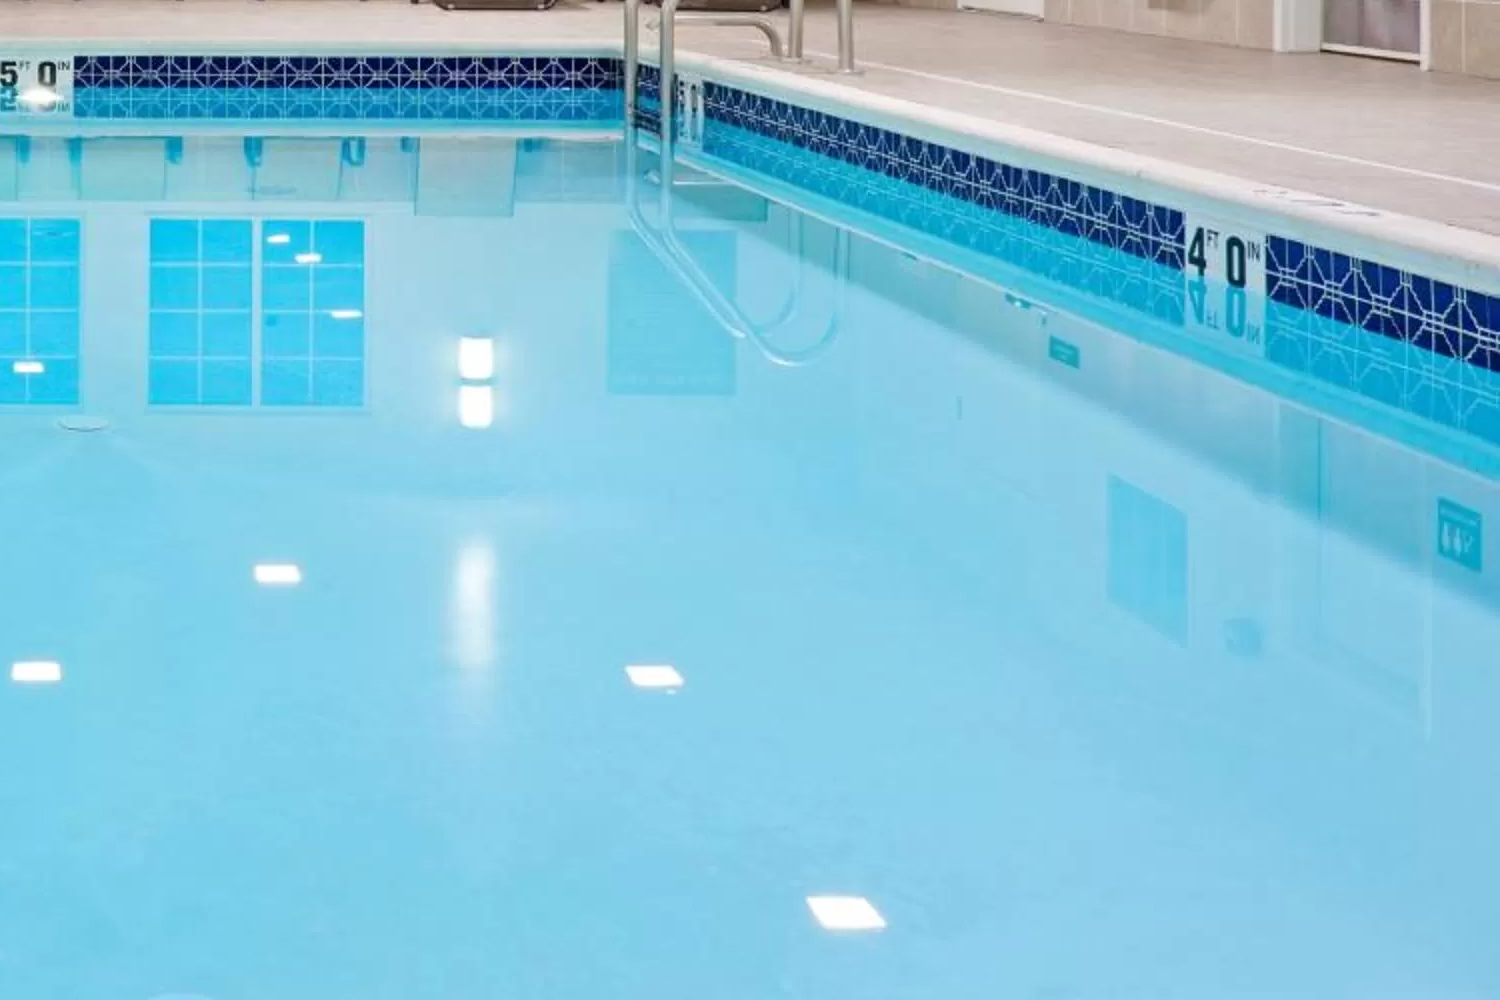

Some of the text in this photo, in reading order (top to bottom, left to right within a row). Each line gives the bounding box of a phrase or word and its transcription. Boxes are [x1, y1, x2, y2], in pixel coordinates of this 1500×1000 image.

[0, 61, 70, 87] 5 FT 0 IN
[1187, 226, 1260, 288] 4 FT 0 IN
